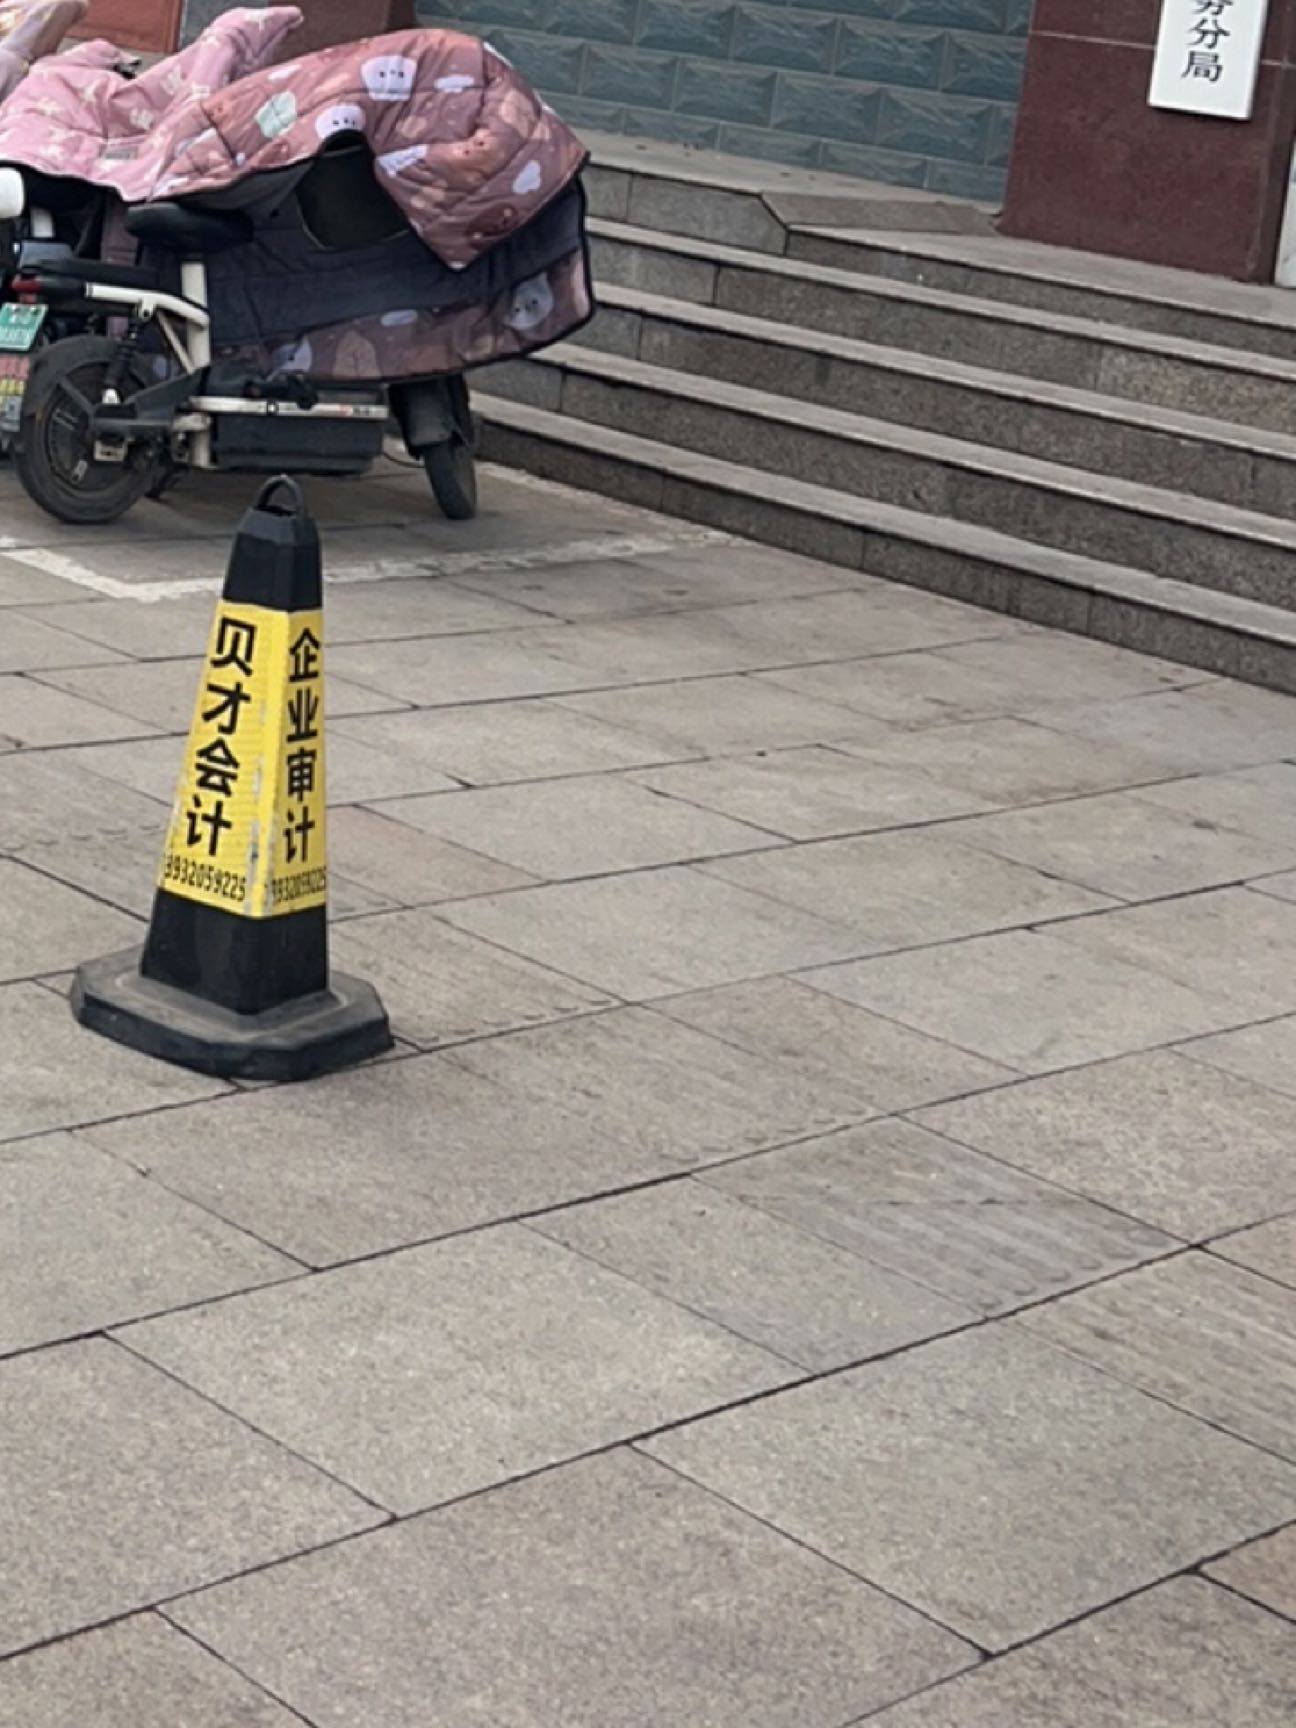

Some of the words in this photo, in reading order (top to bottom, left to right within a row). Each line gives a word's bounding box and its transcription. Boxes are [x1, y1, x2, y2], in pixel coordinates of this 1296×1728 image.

[185, 616, 258, 857] 贝才会计
[283, 626, 321, 864] 企业审计
